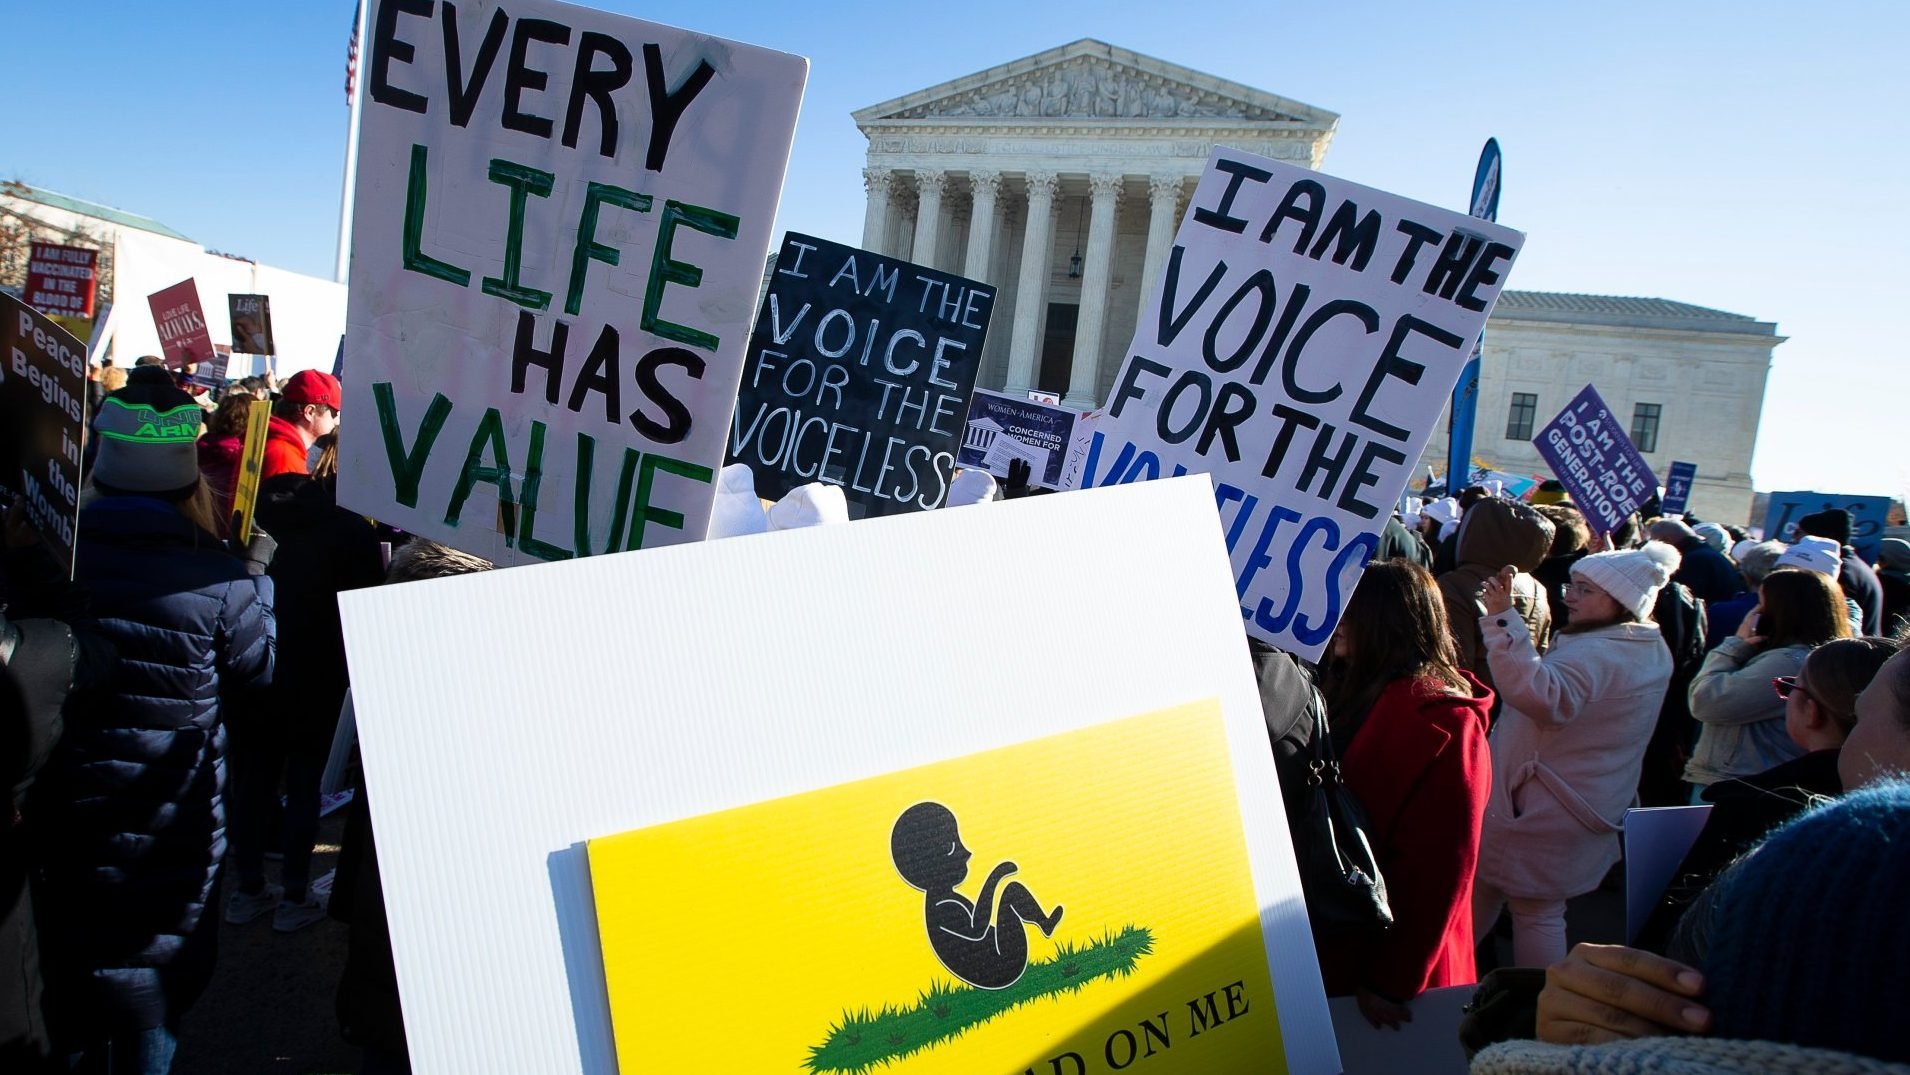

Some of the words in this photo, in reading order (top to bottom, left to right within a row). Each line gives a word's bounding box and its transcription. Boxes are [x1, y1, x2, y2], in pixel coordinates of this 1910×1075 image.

[370, 0, 716, 172] EVERY
[43, 247, 60, 260] AM
[403, 144, 740, 353] LIFE
[1193, 158, 1273, 234] I
[1259, 179, 1382, 272] AM
[1390, 219, 1516, 313] THE
[236, 298, 258, 315] Life
[779, 240, 817, 278] I
[829, 255, 899, 304] AM
[916, 275, 991, 330] THE
[11, 346, 81, 424] Begins
[19, 309, 83, 378] Peace
[510, 310, 706, 444] HAS
[769, 293, 967, 390] VOICE
[1157, 244, 1465, 442] VOICE
[753, 349, 850, 410] FOR
[873, 378, 963, 437] THE
[987, 403, 1017, 416] WOMEN
[1008, 425, 1062, 443] CONCERNED
[1109, 355, 1257, 462] FOR
[1261, 403, 1407, 519] THE
[48, 458, 76, 507] the
[62, 427, 78, 467] in
[732, 394, 955, 511] VOICELESS
[1042, 442, 1061, 452] FOR
[1548, 428, 1622, 528] GENERATION
[1559, 409, 1638, 516] POST-ROE
[1577, 401, 1589, 413] I
[1586, 419, 1615, 452] AM
[1615, 452, 1646, 496] THE
[23, 468, 73, 549] Womb
[1104, 1011, 1172, 1070] ON
[1186, 980, 1250, 1038] ME
